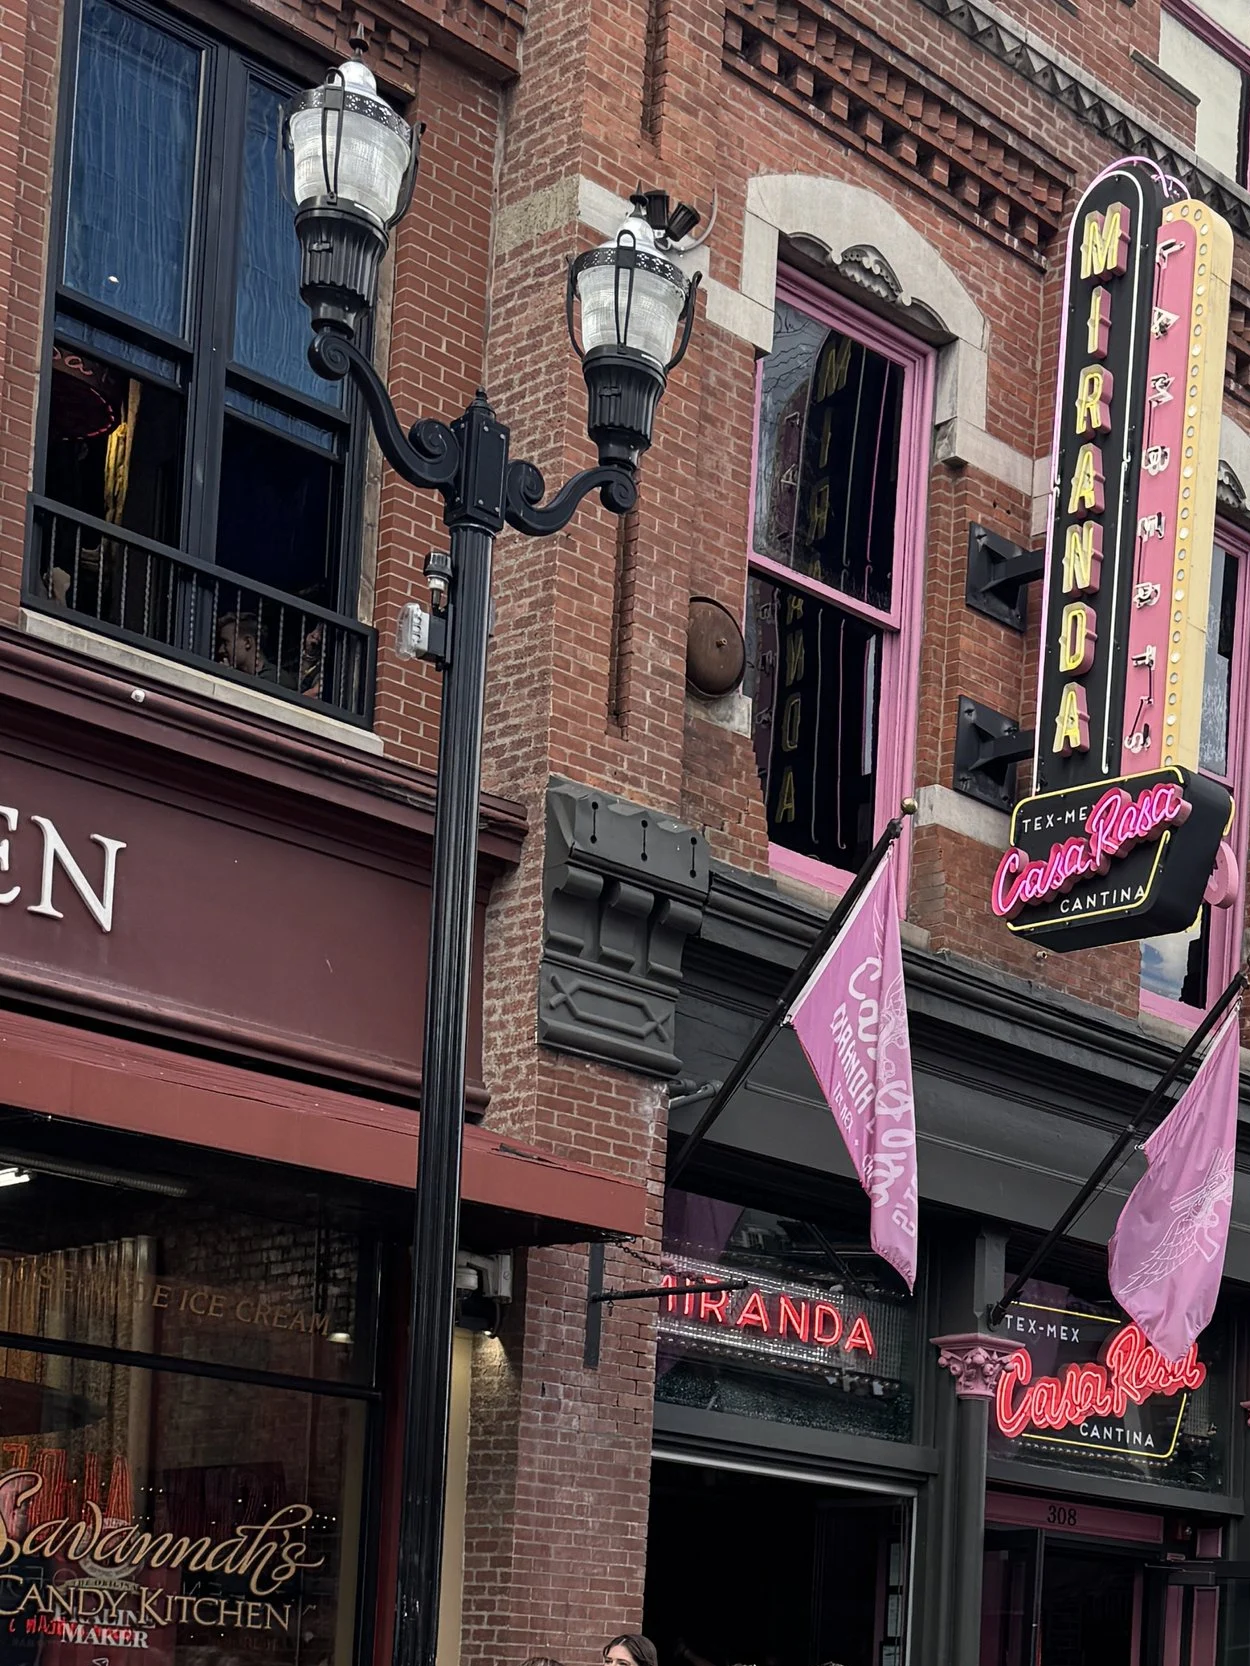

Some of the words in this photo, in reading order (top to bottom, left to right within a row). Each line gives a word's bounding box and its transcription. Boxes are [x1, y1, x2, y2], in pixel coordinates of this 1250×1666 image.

[1052, 202, 1131, 758] MIRANDA
[1022, 806, 1098, 834] TEX-ME
[991, 847, 1101, 918] Casa
[1086, 785, 1192, 868] Rosa
[1060, 885, 1146, 914] CANTINA
[179, 1291, 227, 1318] ICE
[235, 1300, 332, 1337] CREAM
[1004, 1314, 1081, 1343] TEX-MEX
[996, 1349, 1110, 1437] Casa
[1079, 1423, 1155, 1448] CANTINA
[1047, 1505, 1077, 1526] 308
[137, 1587, 291, 1630] KITCHEN
[60, 1623, 149, 1649] MAKER
